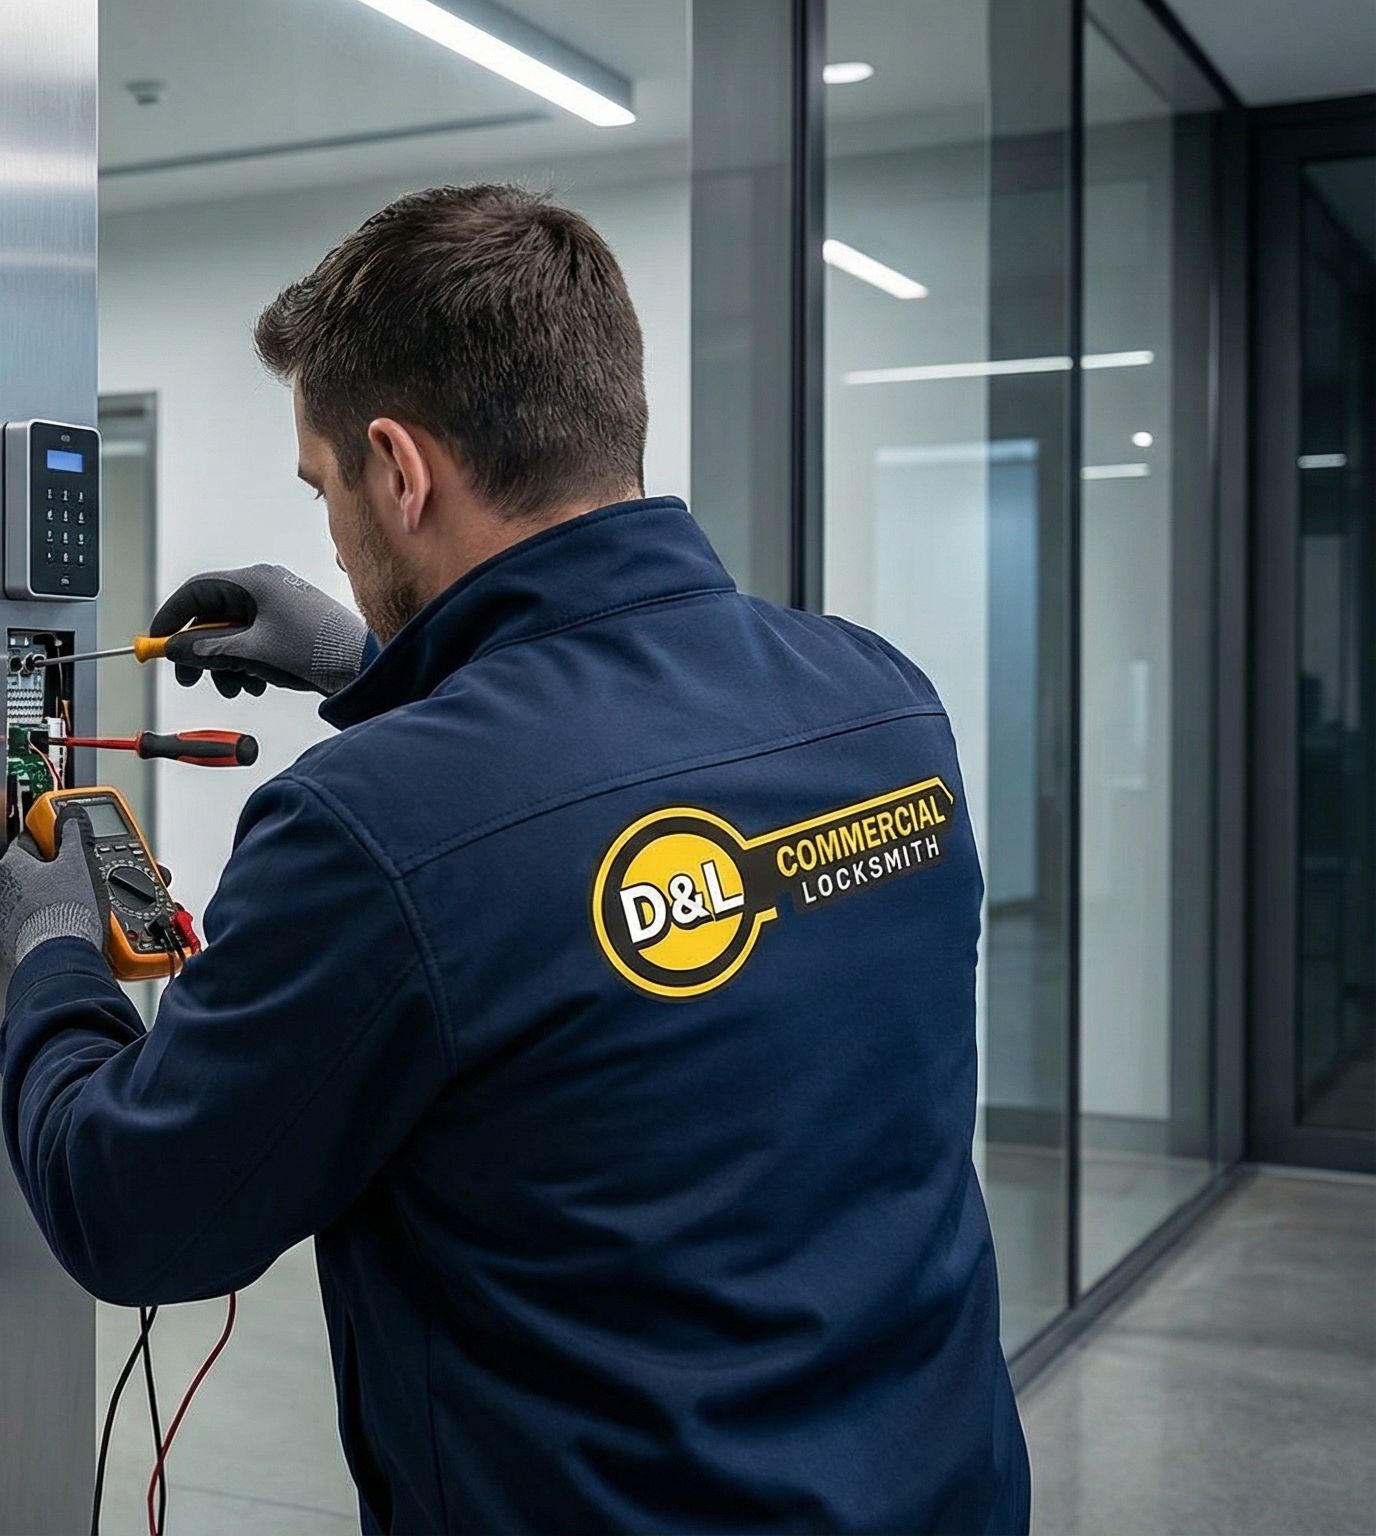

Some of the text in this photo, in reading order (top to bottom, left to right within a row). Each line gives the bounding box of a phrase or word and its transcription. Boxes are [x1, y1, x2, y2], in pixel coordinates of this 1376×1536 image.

[776, 795, 946, 877] COMMERCIAL
[801, 834, 940, 904] LOCKSMITH
[620, 861, 745, 944] D&L
